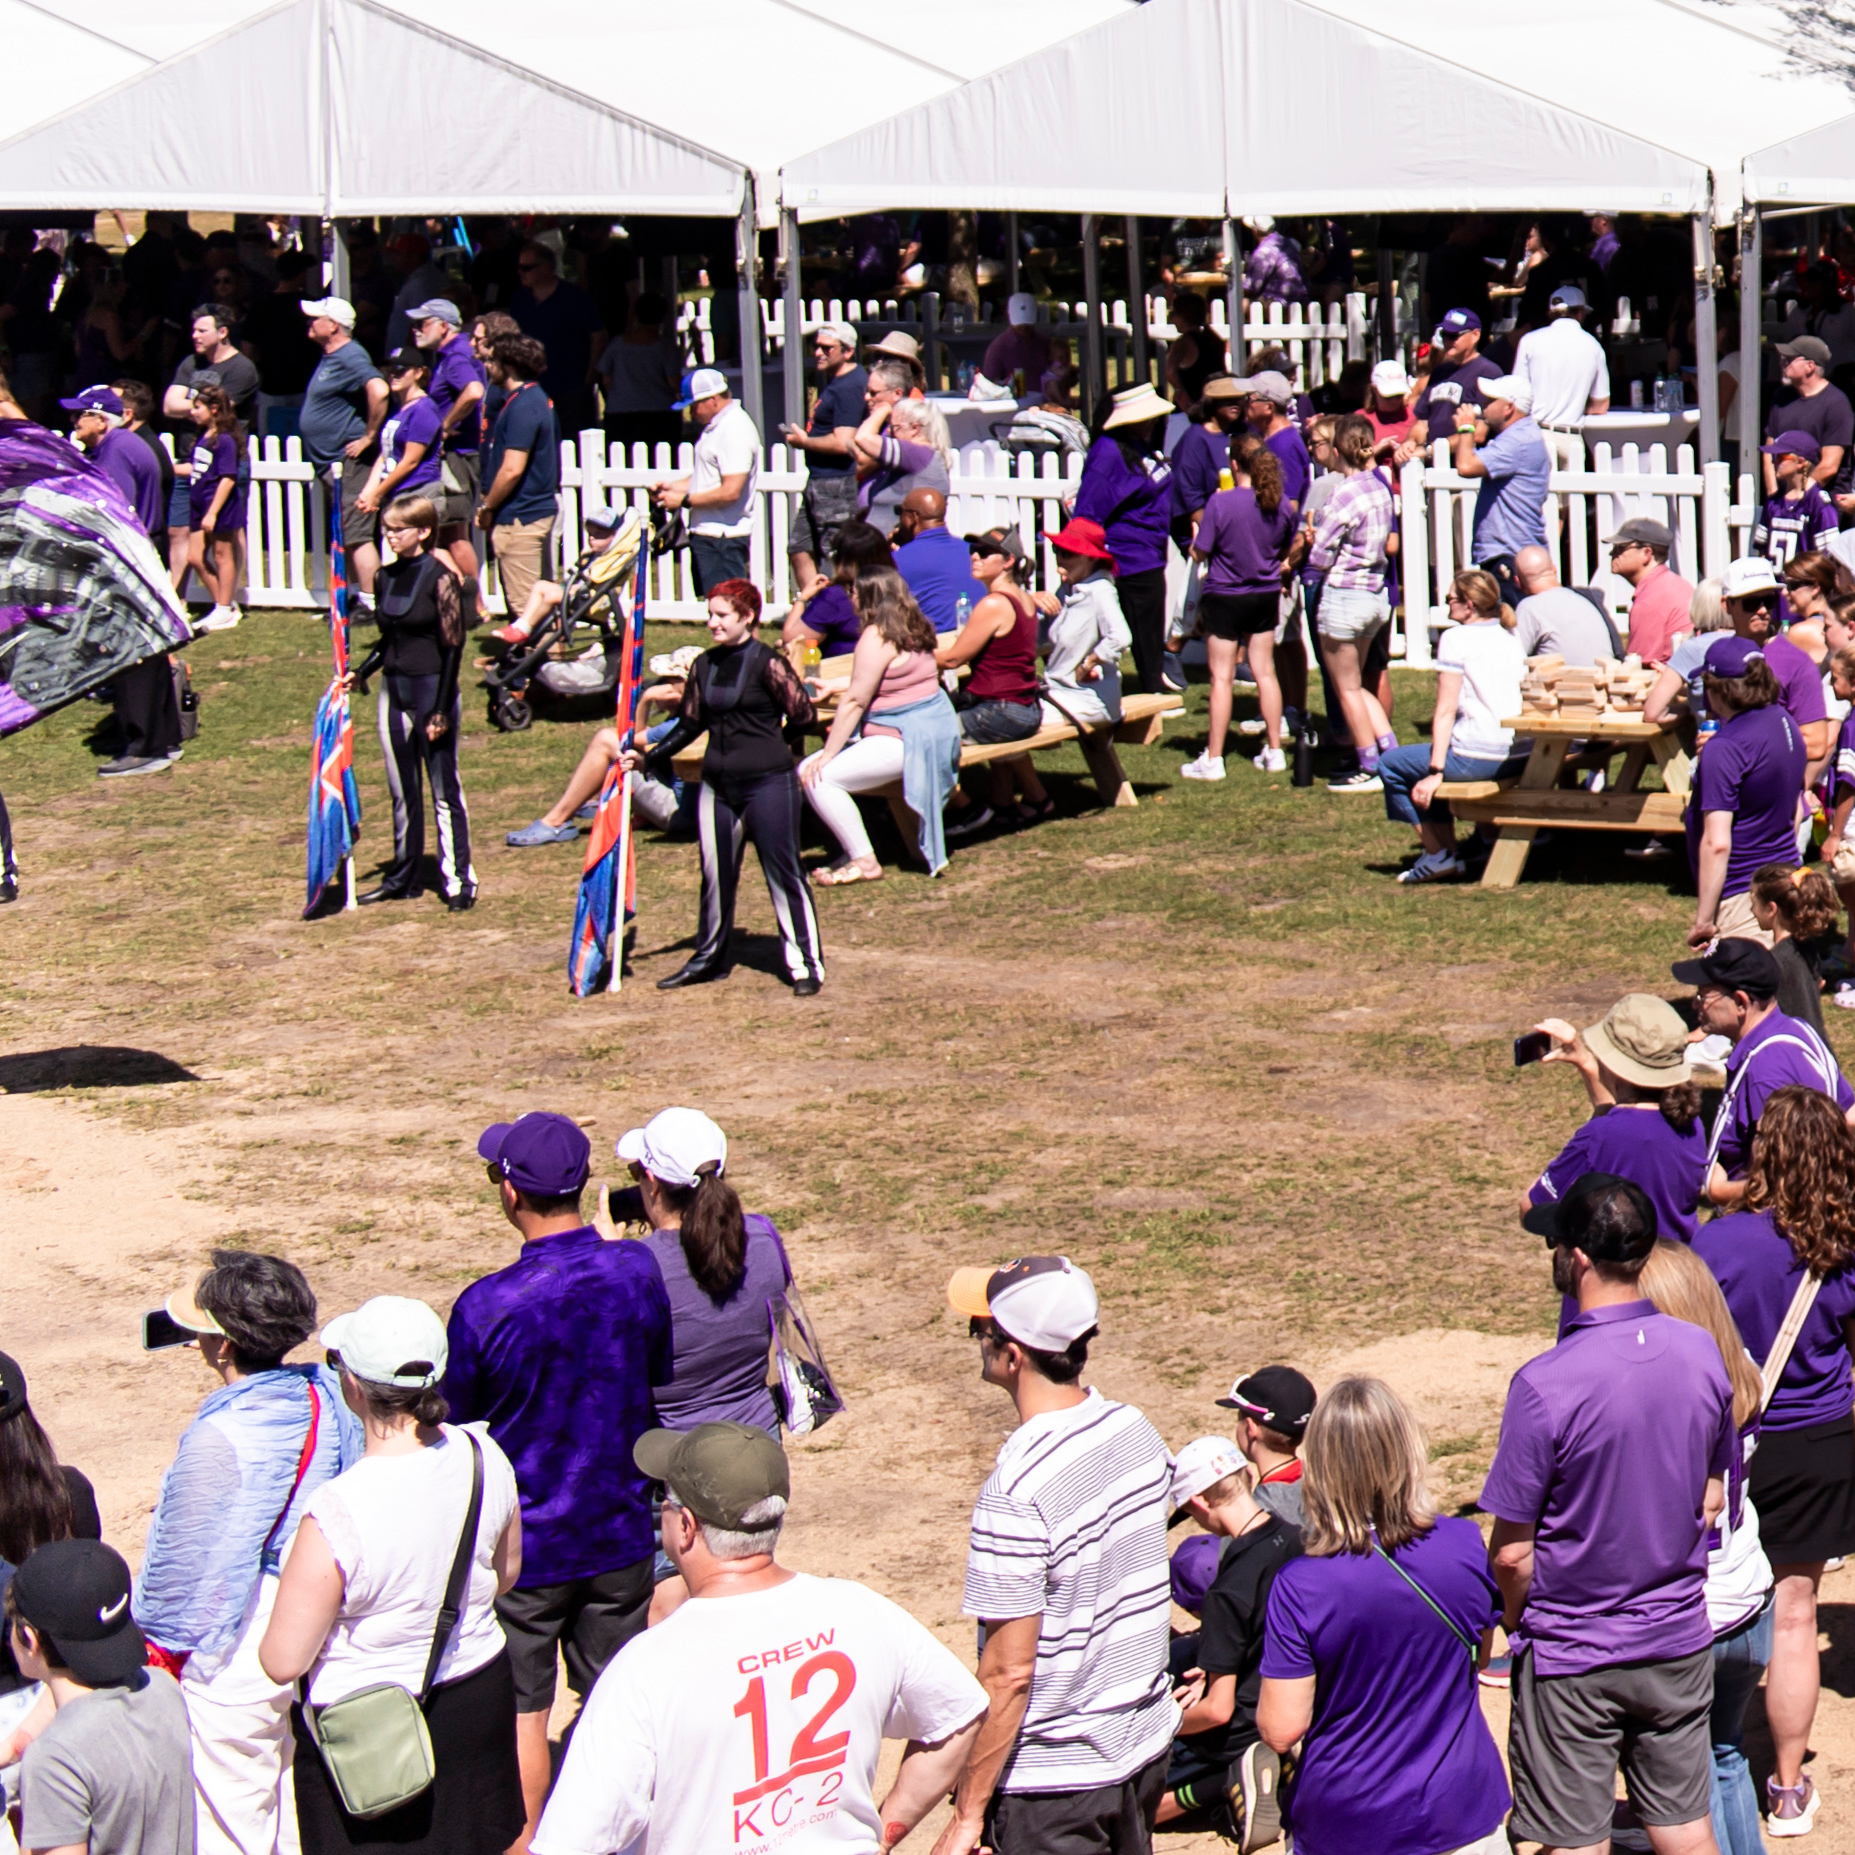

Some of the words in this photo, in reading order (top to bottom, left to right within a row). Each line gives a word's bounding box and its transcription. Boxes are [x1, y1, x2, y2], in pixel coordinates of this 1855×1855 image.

[1769, 531, 1797, 575] 51
[737, 1628, 835, 1674] CREW
[733, 1651, 857, 1783] 12
